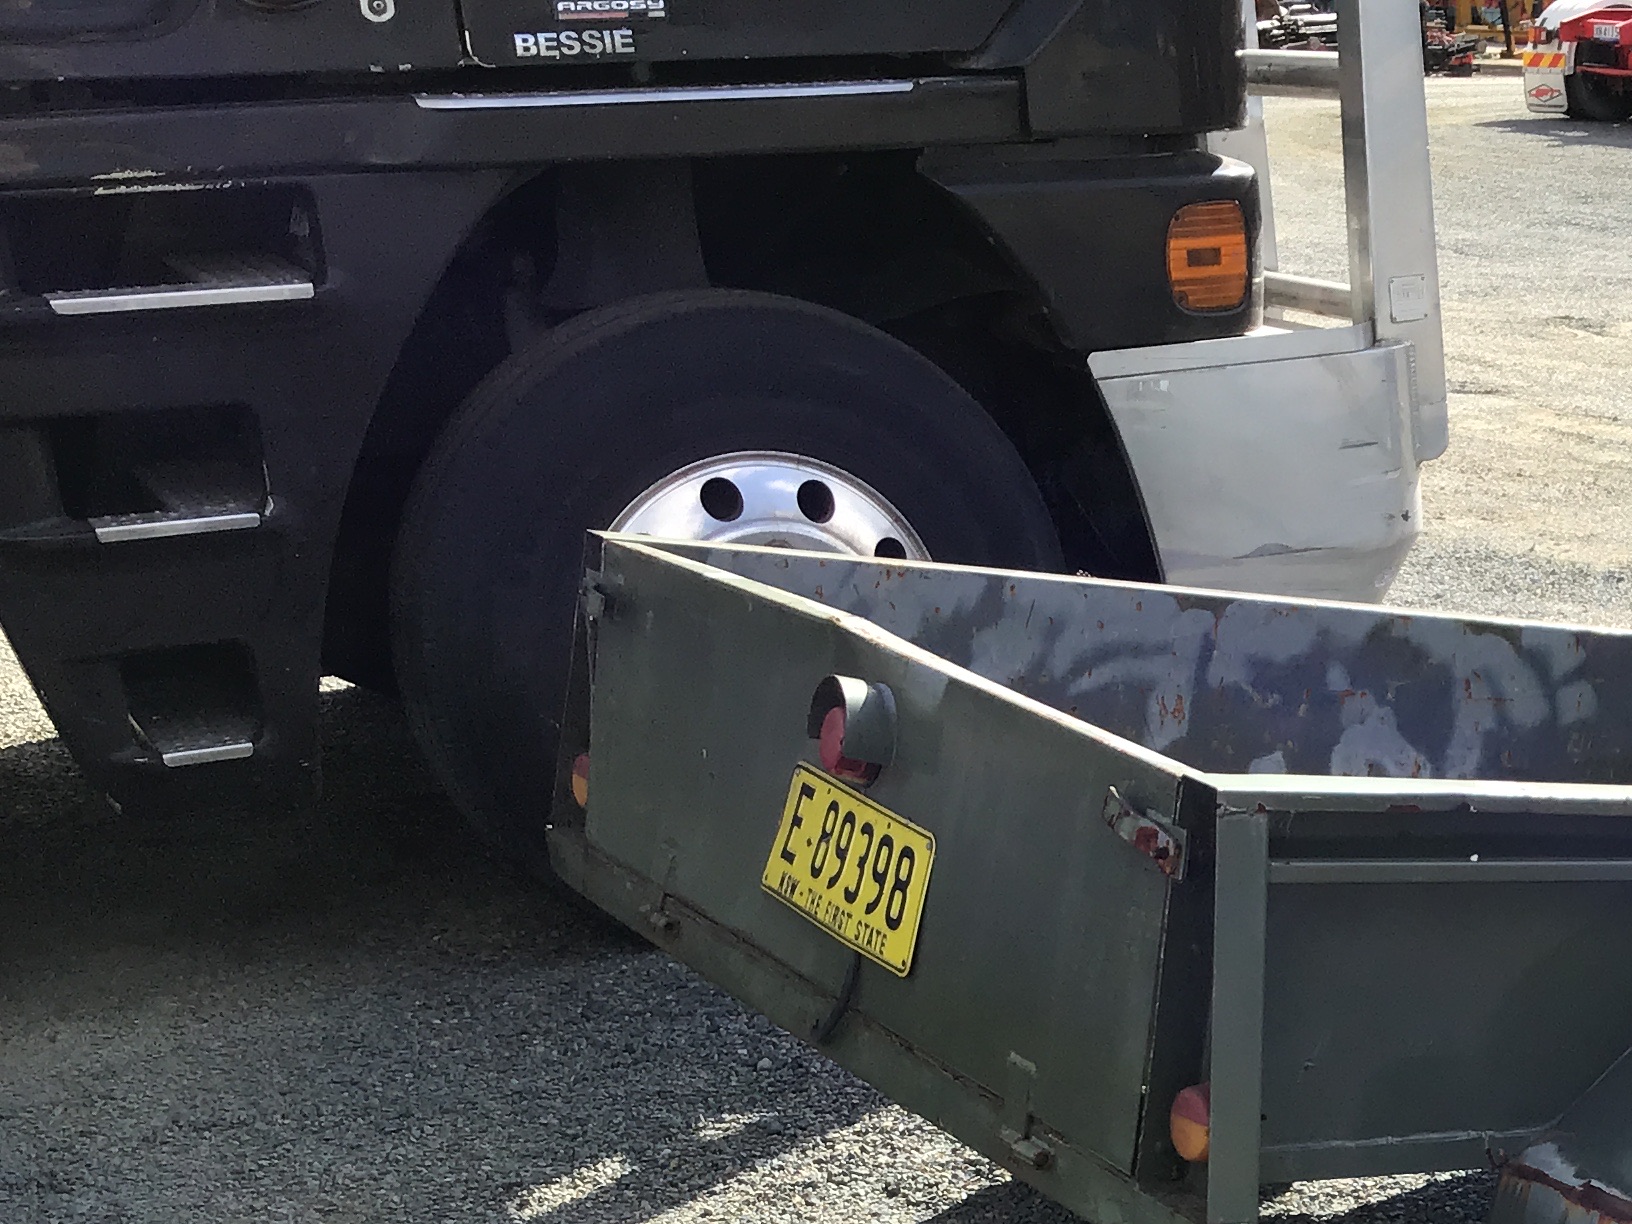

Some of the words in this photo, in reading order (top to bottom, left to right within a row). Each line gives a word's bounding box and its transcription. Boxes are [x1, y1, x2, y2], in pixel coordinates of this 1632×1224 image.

[557, 0, 665, 11] ARGOSY
[513, 29, 636, 58] BESSIE
[805, 888, 824, 916] THE
[824, 900, 854, 935] FIRST
[854, 920, 888, 956] STATE
